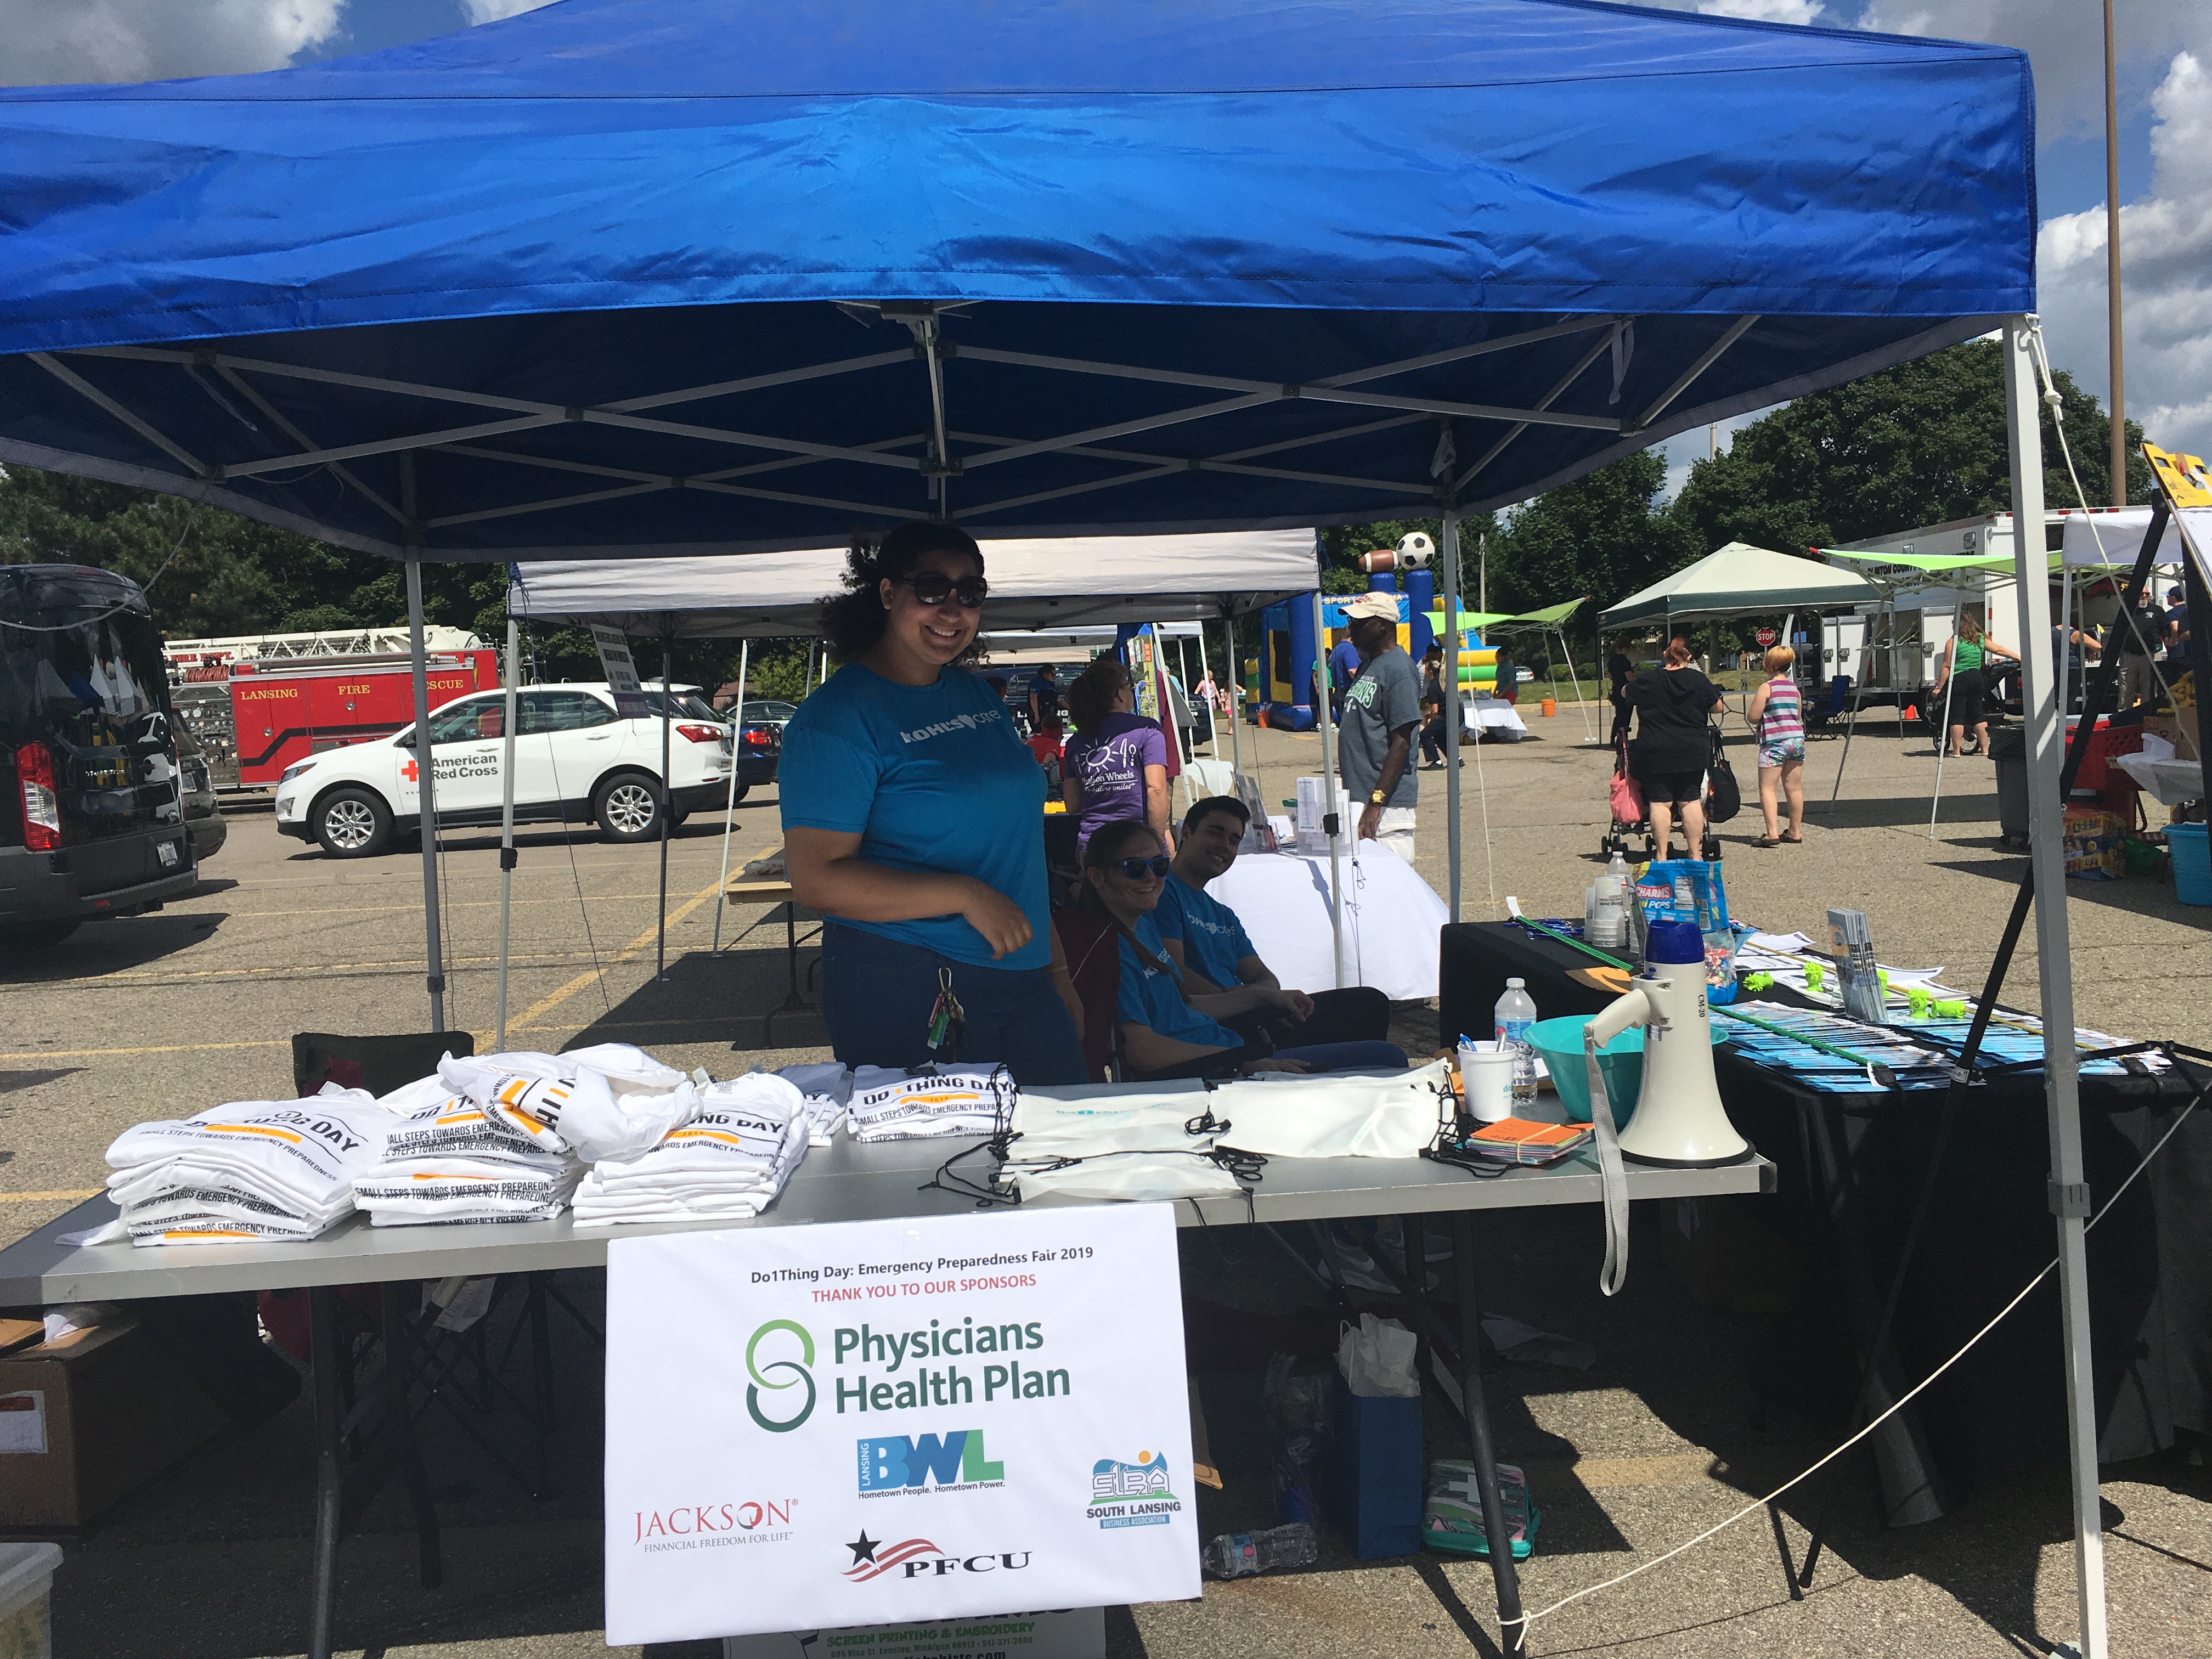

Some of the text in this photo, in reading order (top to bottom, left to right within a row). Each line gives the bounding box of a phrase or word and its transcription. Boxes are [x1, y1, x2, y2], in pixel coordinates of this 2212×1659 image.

[1323, 596, 1357, 605] SPORT
[171, 653, 198, 663] FIRE
[241, 679, 464, 700] LANSING FIRE ESCUE
[432, 755, 497, 768] American
[432, 767, 498, 780] Red Cross
[1105, 770, 1135, 781] Wheels
[1636, 885, 1670, 899] CHARMS
[1648, 900, 1671, 910] POPS
[864, 1091, 889, 1105] DO
[907, 1077, 965, 1092] THING
[410, 1105, 441, 1120] DO
[445, 1099, 455, 1113] 1
[881, 1108, 903, 1121] STEPS
[900, 1102, 932, 1115] TOWARDS
[933, 1103, 972, 1114] EMERGENCY
[405, 1130, 430, 1142] STEPS
[432, 1125, 471, 1138] TOWARDS
[736, 1119, 784, 1134] DAY
[310, 1121, 360, 1153] DAY
[419, 1141, 456, 1153] TOWARDS
[459, 1140, 506, 1152] EMERGENCY
[682, 1140, 729, 1152] EMERGENCY
[195, 1132, 234, 1141] TOWARDS
[236, 1135, 285, 1147] EMERGENCY
[283, 1144, 337, 1182] PREPAREDNESS
[451, 1183, 499, 1194] EMERGENCY
[501, 1182, 551, 1192] PREPAREDN
[196, 1190, 244, 1206] EMERGENCY
[218, 1222, 266, 1234] EMERGENCY
[751, 1246, 1093, 1283] Do1Thing Day: Emergency Preparedness Fair 2019
[811, 1274, 1036, 1303] THANK YOU TO OUR SPONSORS
[834, 1316, 1043, 1373] Physicians
[836, 1361, 1070, 1414] Health Plan
[857, 1429, 1005, 1492] BWL
[861, 1443, 871, 1486] LANSING
[859, 1490, 901, 1499] Hometown
[903, 1486, 932, 1496] People.
[935, 1483, 978, 1493] Hometown
[1086, 1501, 1181, 1519] SOUTH LANSING
[1103, 1515, 1166, 1528] BUSINESS ASSOCIATION
[644, 1540, 697, 1553] FINANCIAL
[700, 1536, 747, 1548] FREEDOM
[749, 1534, 769, 1543] FOR
[901, 1551, 1033, 1579] PFCU
[827, 1621, 1036, 1647] SCREEN PRINTING & EMBROIDERY
[914, 1643, 950, 1652] Michigan
